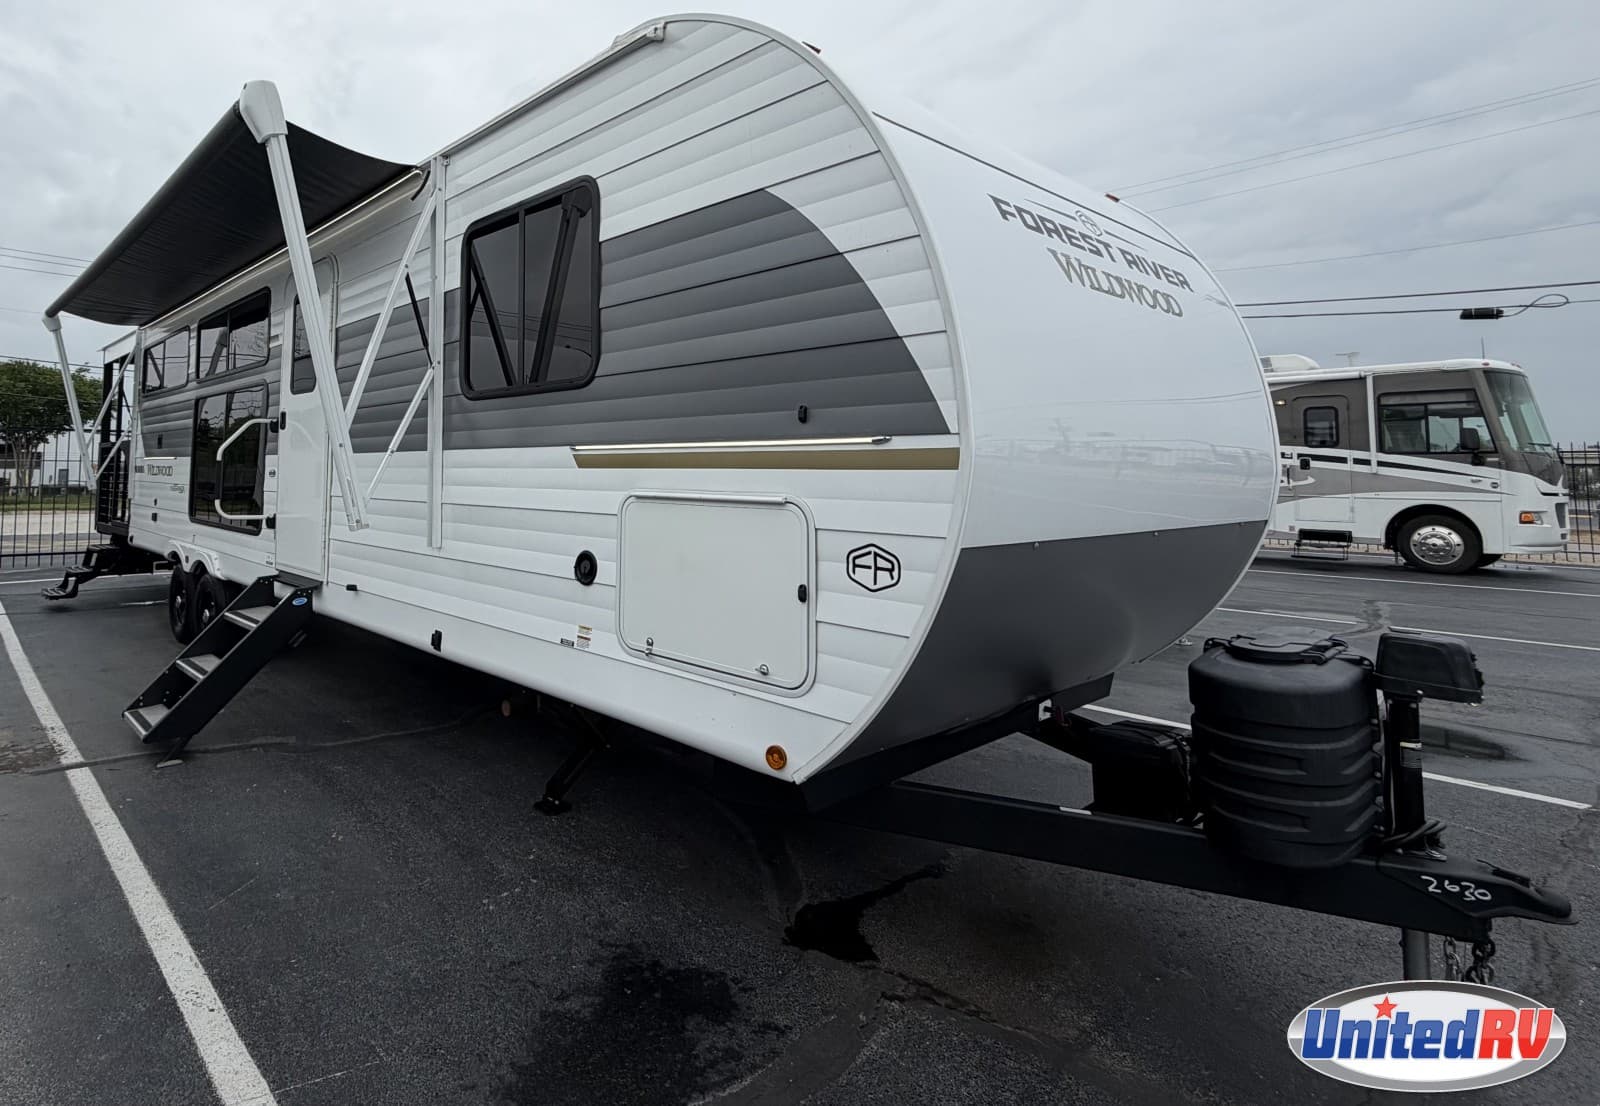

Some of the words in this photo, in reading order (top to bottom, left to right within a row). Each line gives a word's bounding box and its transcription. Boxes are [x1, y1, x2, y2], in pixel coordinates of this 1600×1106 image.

[986, 192, 1117, 263] FOREST
[1115, 246, 1194, 293] RIVER
[1046, 246, 1183, 318] WILDWOOD
[1420, 875, 1492, 901] 2630
